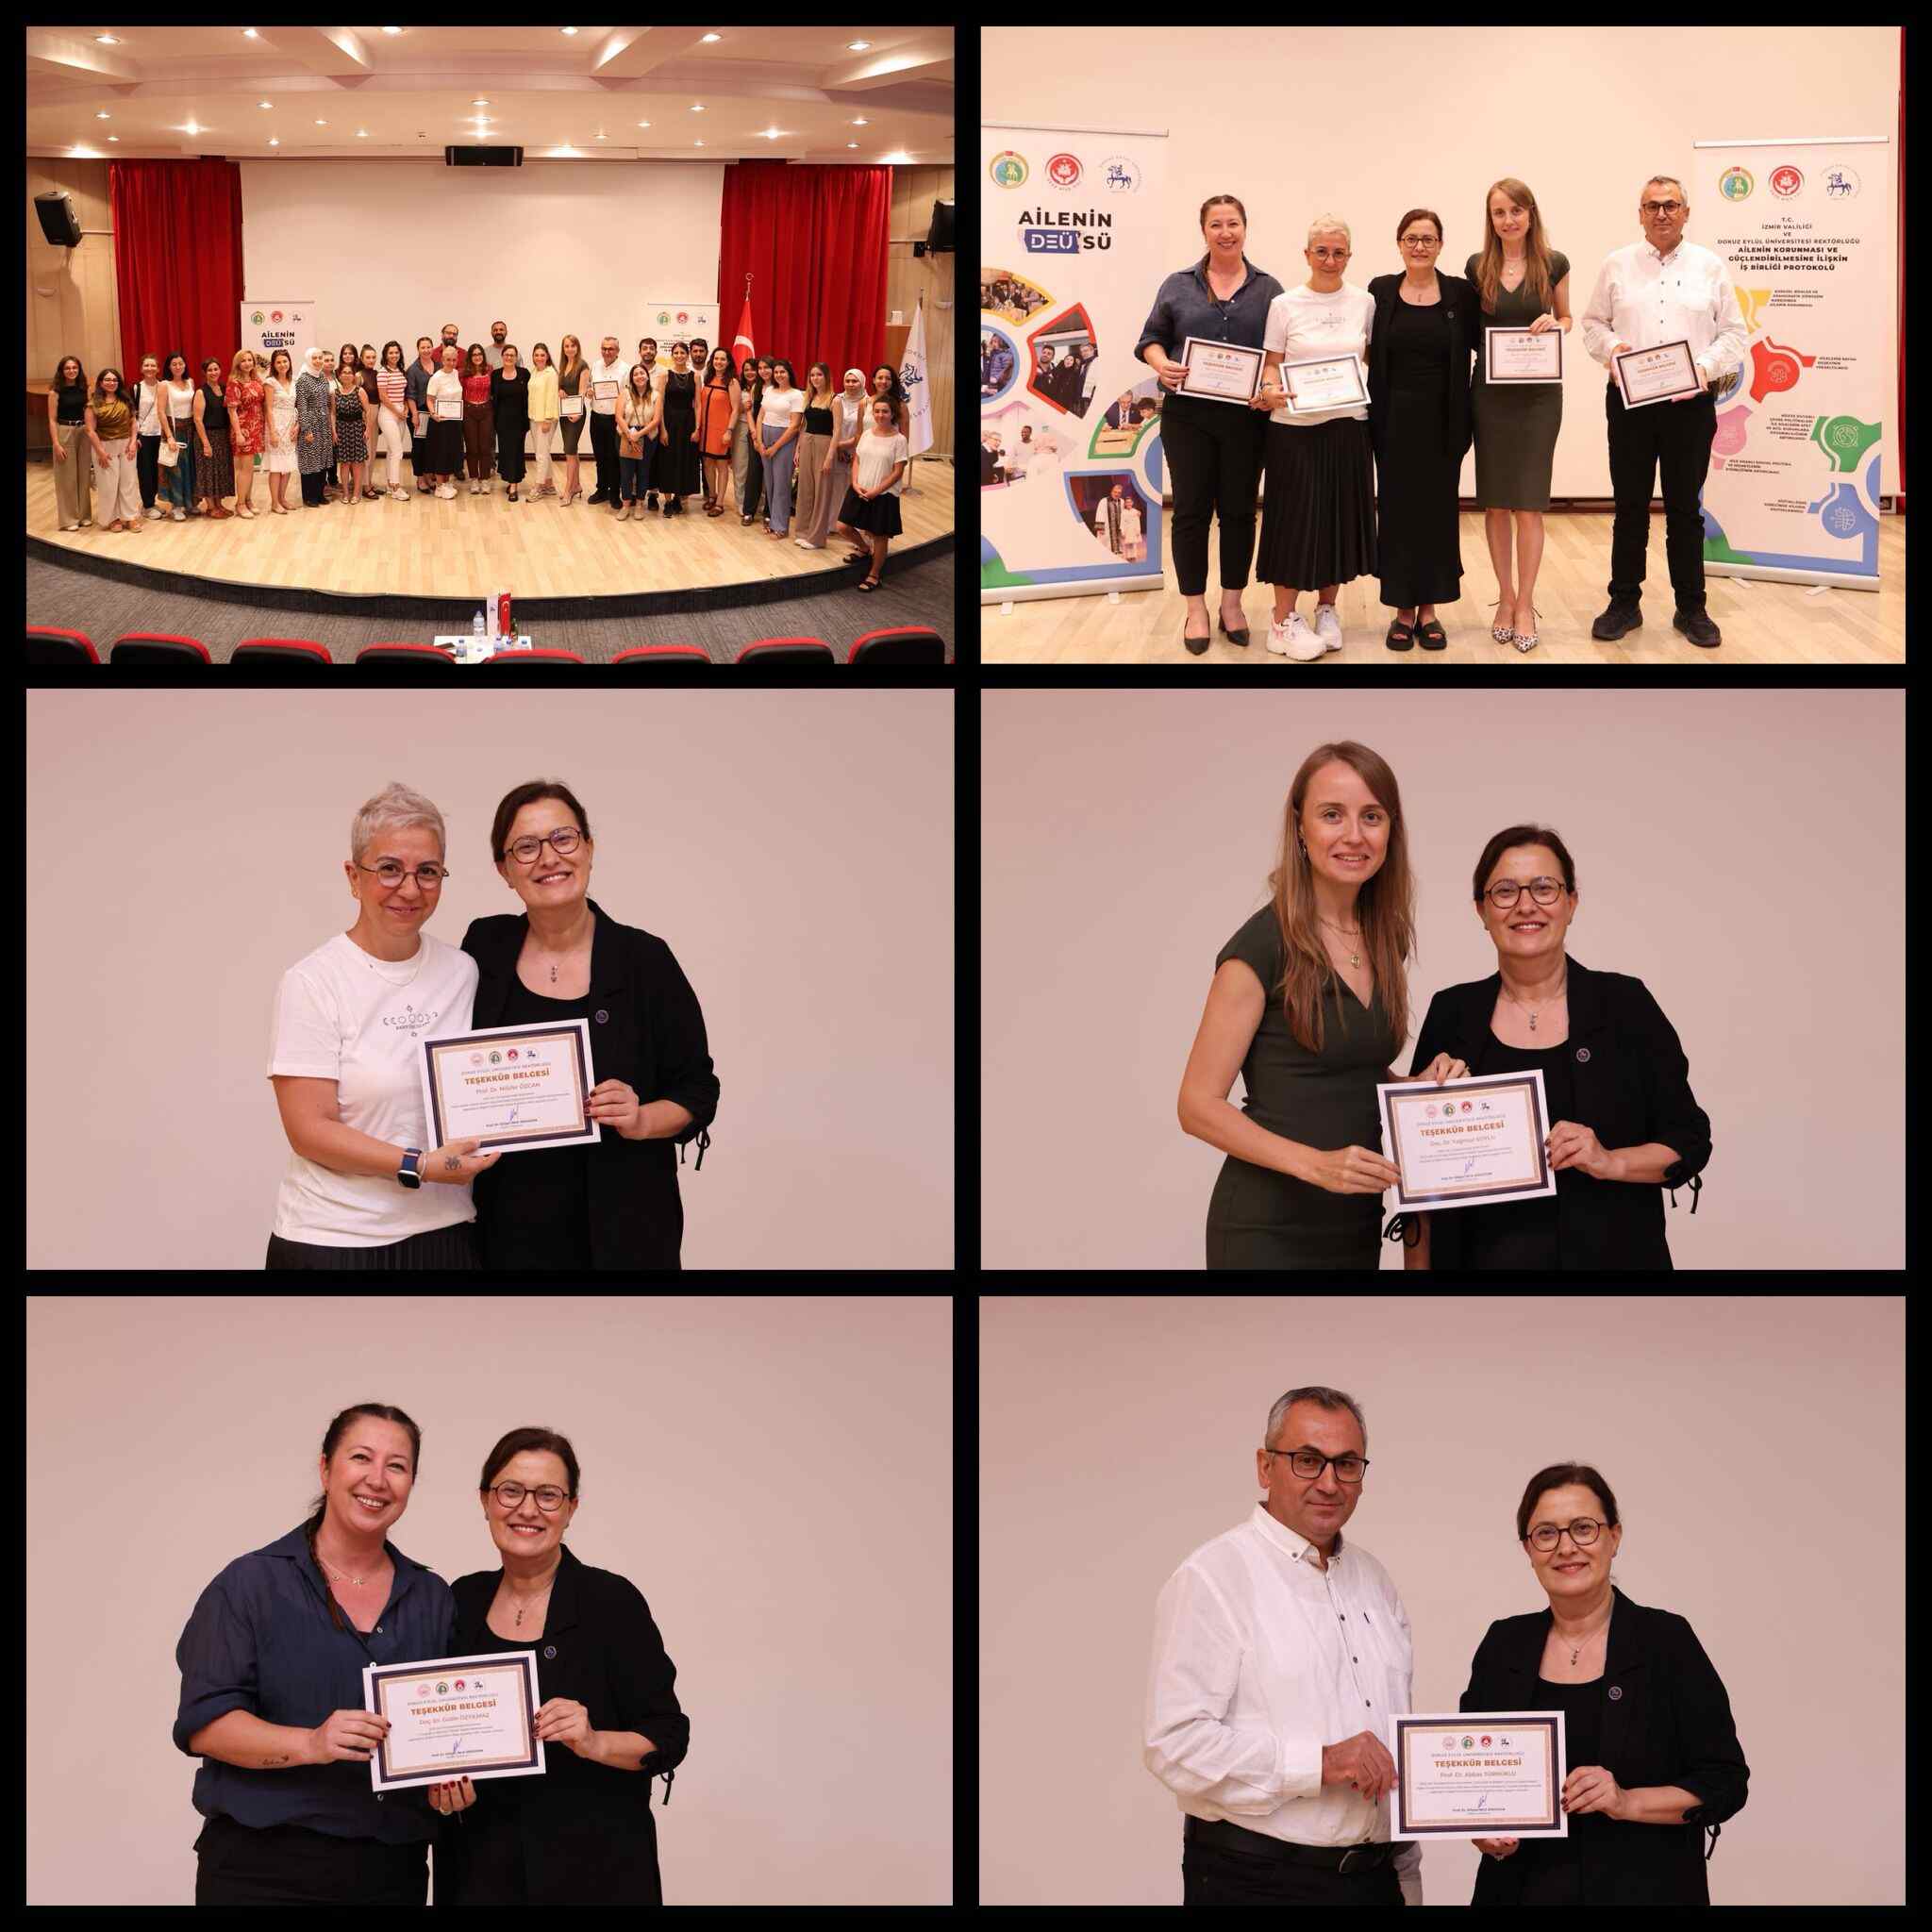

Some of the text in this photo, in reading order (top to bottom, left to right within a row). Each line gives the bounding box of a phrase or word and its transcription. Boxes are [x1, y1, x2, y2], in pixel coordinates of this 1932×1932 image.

[1018, 207, 1112, 227] AİLENİN
[1728, 254, 1848, 263] GÜÇLENDİRİLMESİNE İLİŞKİN
[261, 330, 295, 339] AİLENİN
[464, 1073, 510, 1086] TEŞEKKÜR
[512, 1067, 550, 1080] BELGESİ
[1420, 1124, 1465, 1138] TEŞEKKÜR
[1466, 1121, 1505, 1133] BELGESİ
[410, 1700, 497, 1717] TEŞEKKÜR BELGESİ
[1433, 1757, 1522, 1770] TEŞEKKÜR BELGESİ
